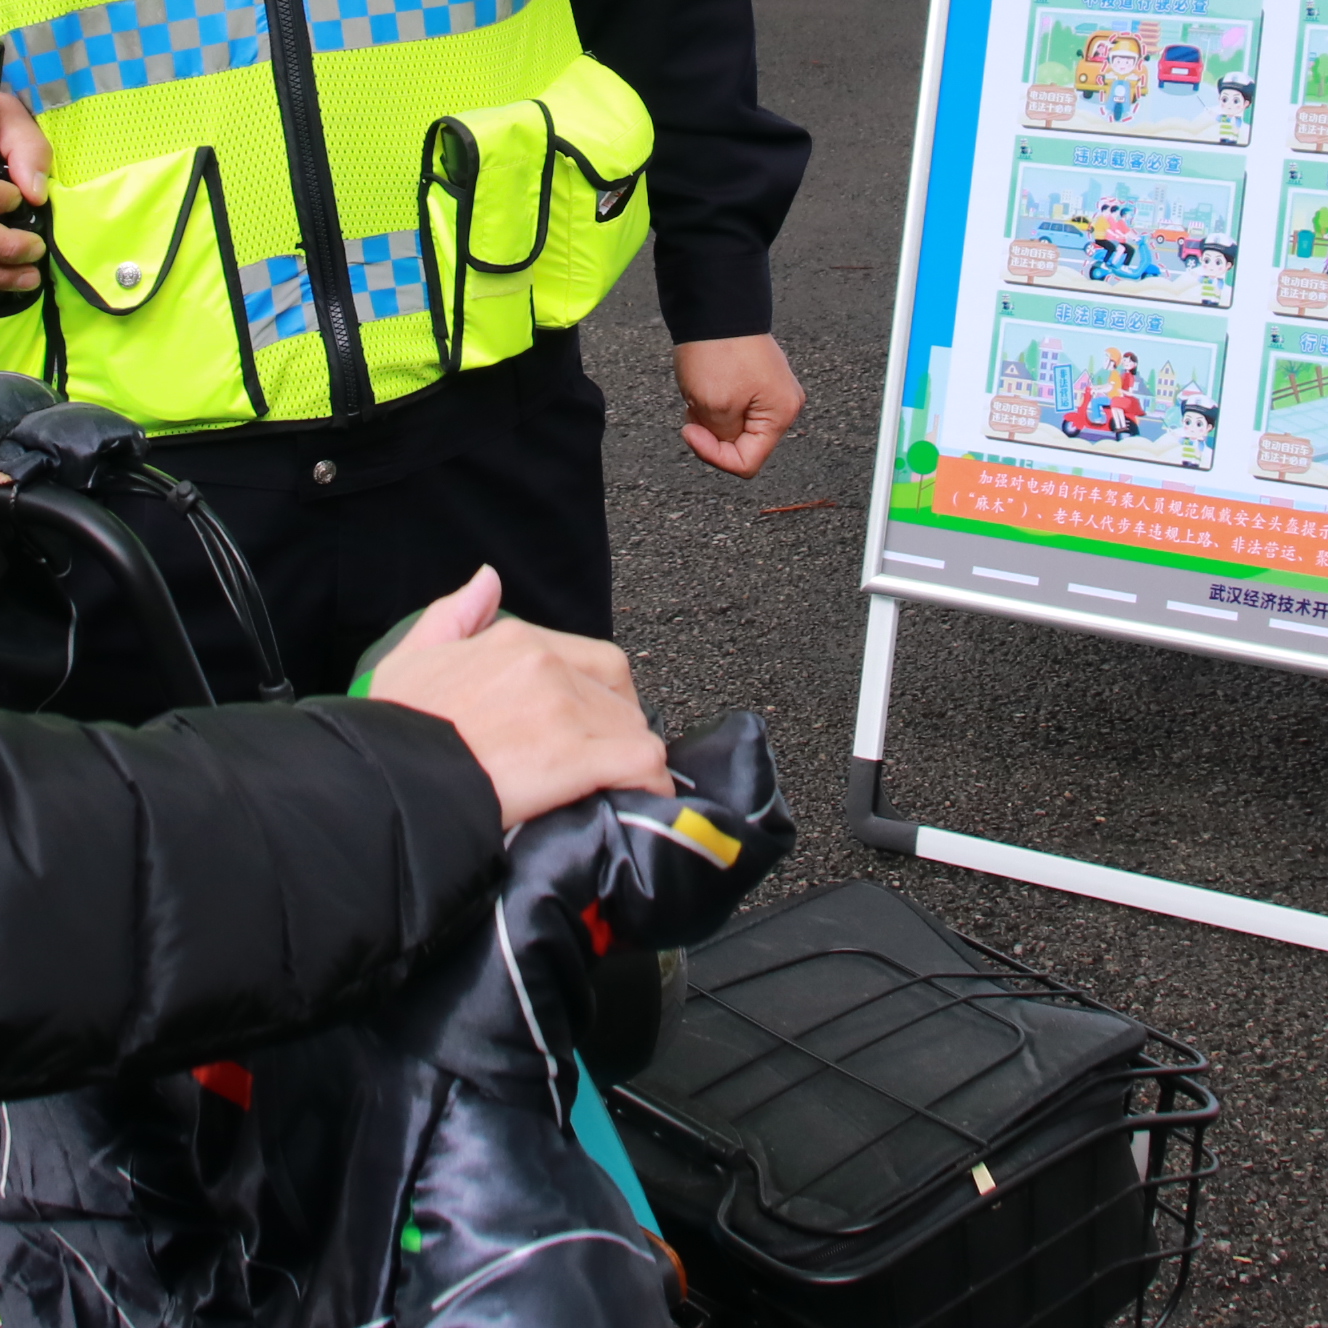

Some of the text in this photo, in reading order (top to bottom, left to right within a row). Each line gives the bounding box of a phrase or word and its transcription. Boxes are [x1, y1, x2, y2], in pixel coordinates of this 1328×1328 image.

[1030, 90, 1073, 103] 电动自行车
[1073, 145, 1182, 174] 违规载客必查
[1012, 245, 1056, 259] 电动自行车
[1281, 276, 1328, 290] 电动自行车
[1055, 303, 1165, 334] 非法营运必查
[993, 402, 1037, 416] 电动自行车
[1261, 439, 1310, 456] 电动自行车
